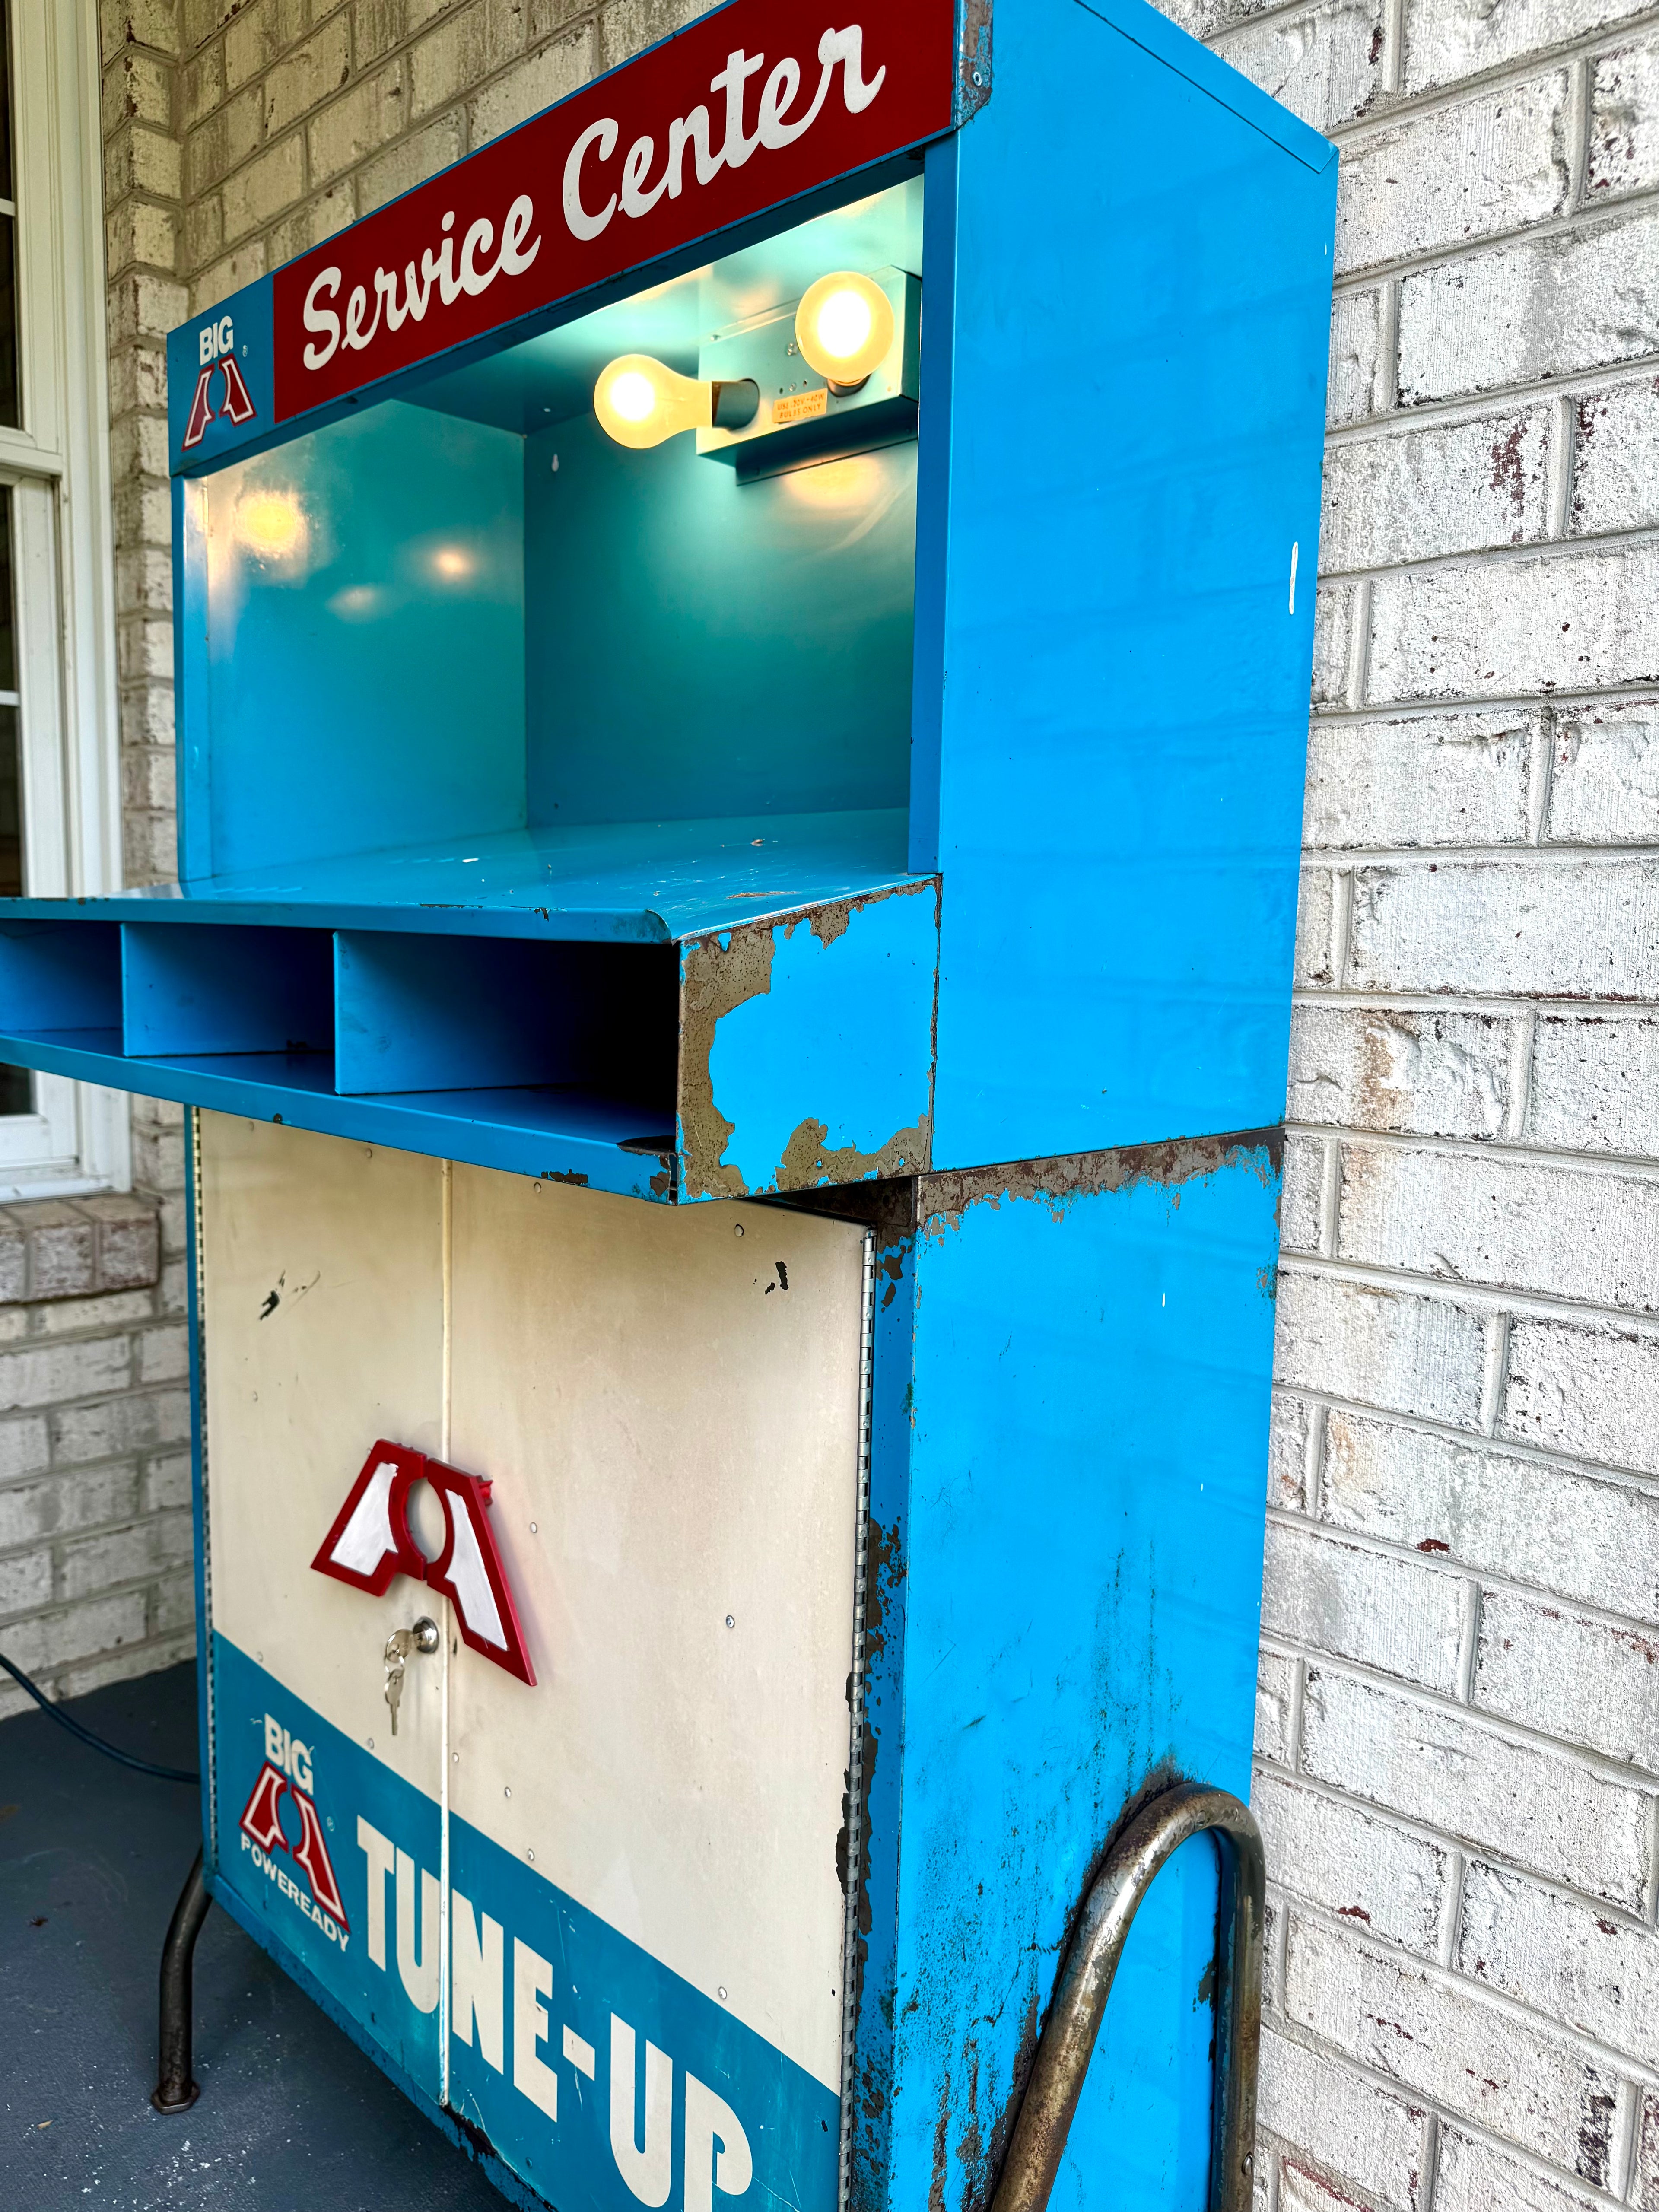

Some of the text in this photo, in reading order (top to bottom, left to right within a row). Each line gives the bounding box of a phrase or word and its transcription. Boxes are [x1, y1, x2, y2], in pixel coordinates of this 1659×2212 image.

[303, 25, 886, 371] Service Center
[200, 315, 234, 366] BIG
[777, 402, 788, 410] USE
[802, 403, 821, 413] ONLY
[264, 1713, 315, 1796] BIG
[241, 1832, 349, 1952] POWEREADY
[357, 1815, 753, 2212] TUNE-UP
